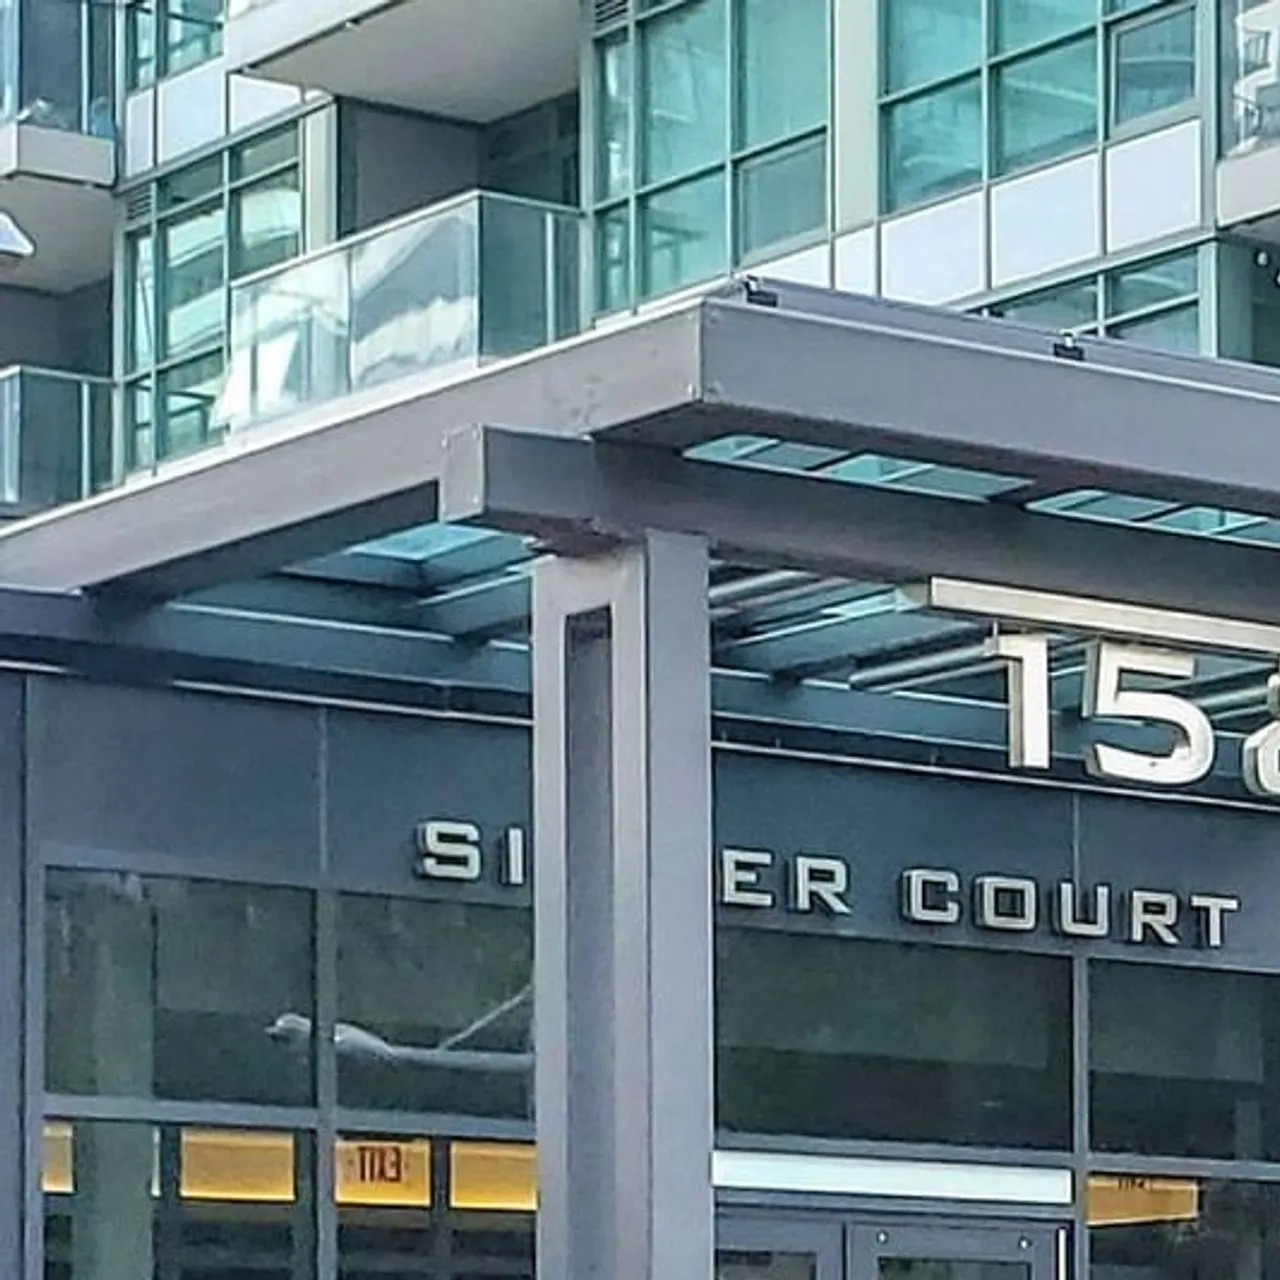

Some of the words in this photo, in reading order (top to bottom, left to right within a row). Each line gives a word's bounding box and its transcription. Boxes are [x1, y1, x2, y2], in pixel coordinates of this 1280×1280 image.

[984, 634, 1214, 787] 15
[417, 819, 853, 916] SIER
[903, 866, 1238, 948] COURT
